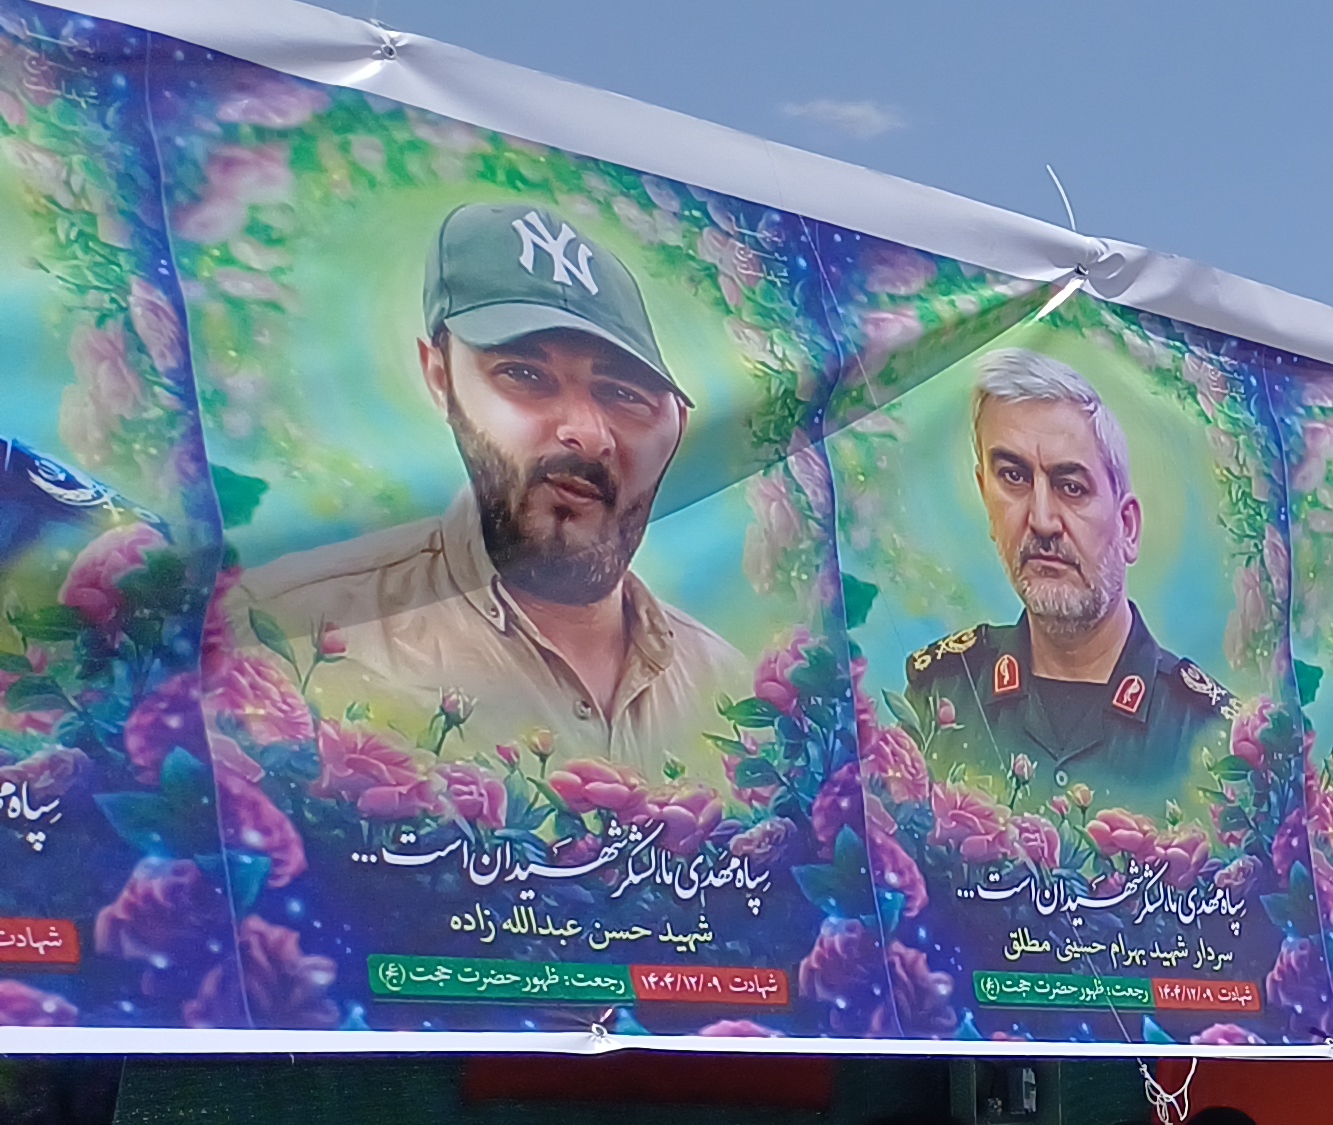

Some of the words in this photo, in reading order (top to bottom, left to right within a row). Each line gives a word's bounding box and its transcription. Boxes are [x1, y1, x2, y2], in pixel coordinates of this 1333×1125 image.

[449, 902, 496, 944] زاده
[501, 905, 582, 947] عبدالله
[588, 919, 652, 950] حسن
[658, 916, 714, 954] شهید
[1004, 928, 1051, 961] مطلق
[1056, 938, 1107, 962] حسینی
[1109, 932, 1147, 969] بهرام
[1149, 935, 1189, 968] شهید
[1193, 938, 1233, 971] سردار
[408, 963, 452, 984] حجت
[456, 968, 519, 992] حضرت
[520, 966, 560, 994] ظهور
[728, 973, 779, 999] شهادت
[1034, 980, 1078, 1001] حضرت
[1217, 986, 1253, 1005] شهادت
